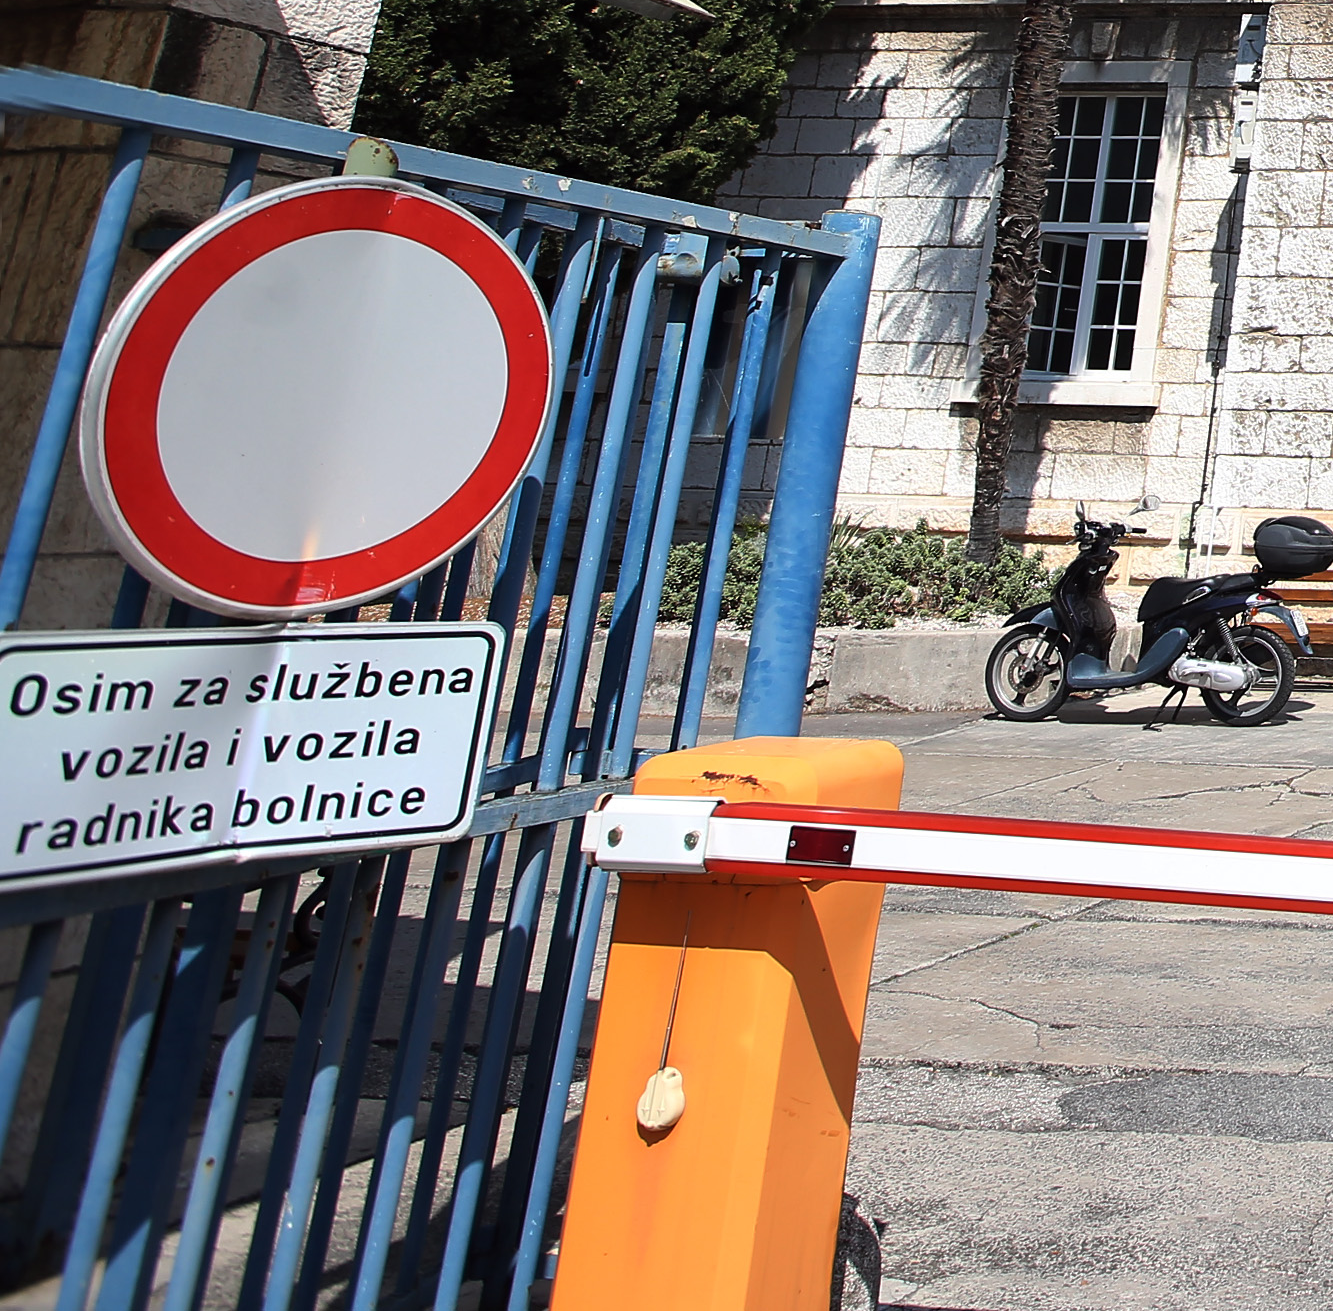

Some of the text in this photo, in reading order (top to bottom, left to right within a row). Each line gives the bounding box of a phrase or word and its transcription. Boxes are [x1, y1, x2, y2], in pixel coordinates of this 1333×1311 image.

[9, 662, 474, 717] Osim za službena
[61, 720, 420, 781] vozila i vozila
[15, 782, 426, 854] radnika bolnice
